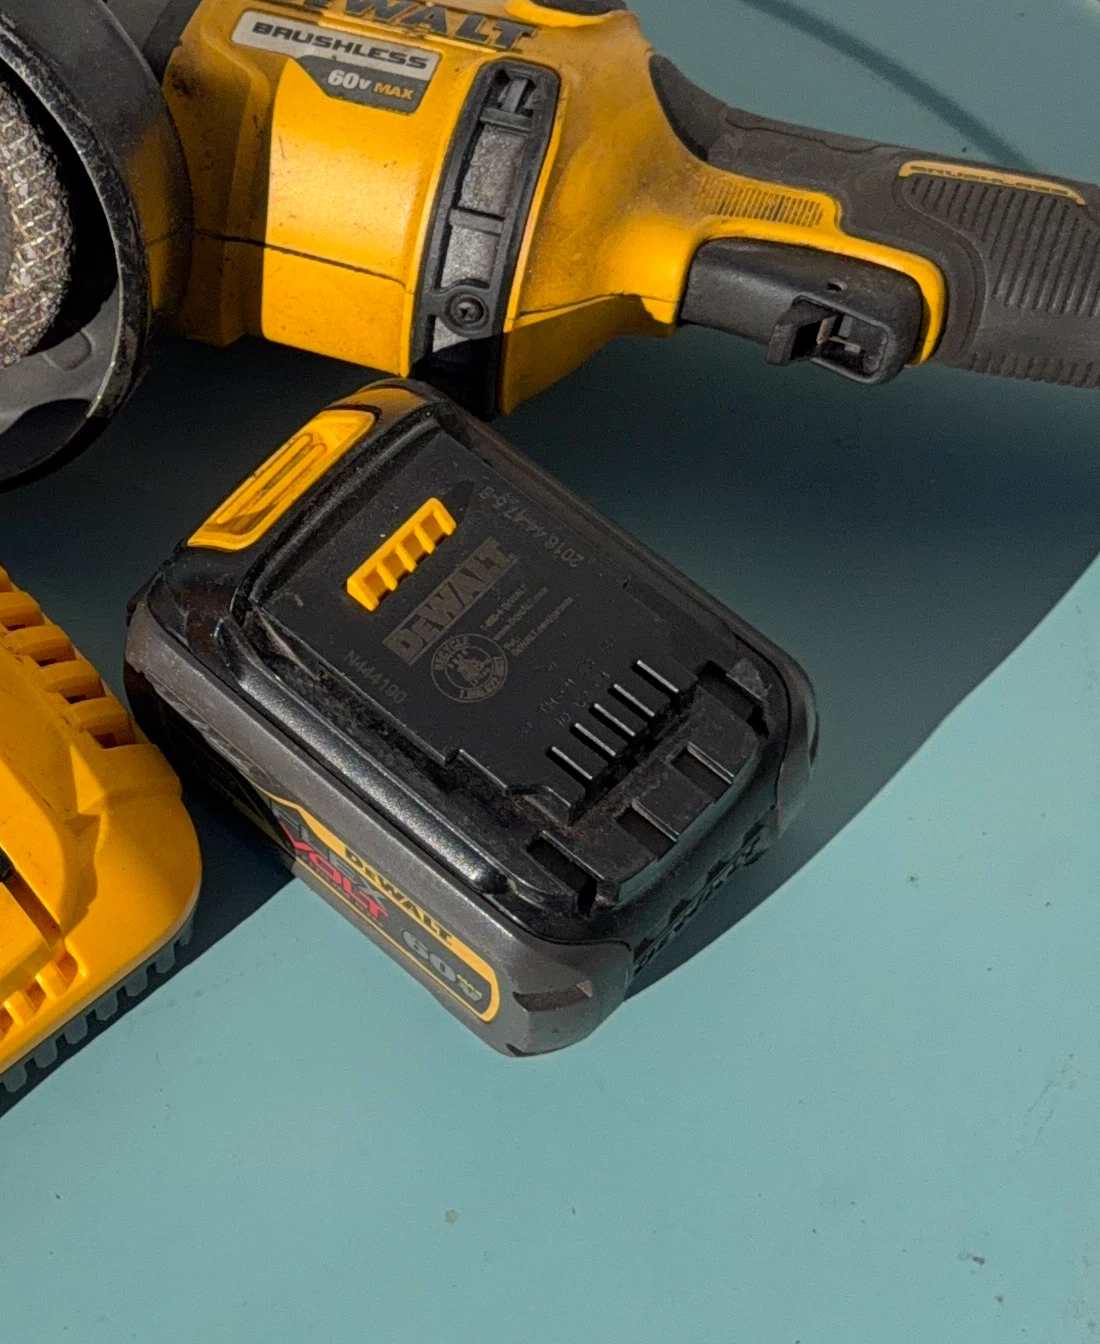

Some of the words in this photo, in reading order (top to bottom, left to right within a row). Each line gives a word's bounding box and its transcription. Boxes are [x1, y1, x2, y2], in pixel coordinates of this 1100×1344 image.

[252, 21, 428, 69] BRUSHLESS
[373, 80, 414, 103] MAX
[272, 802, 386, 908] FLEX
[278, 819, 391, 918] VOLT
[399, 929, 459, 982] 60
